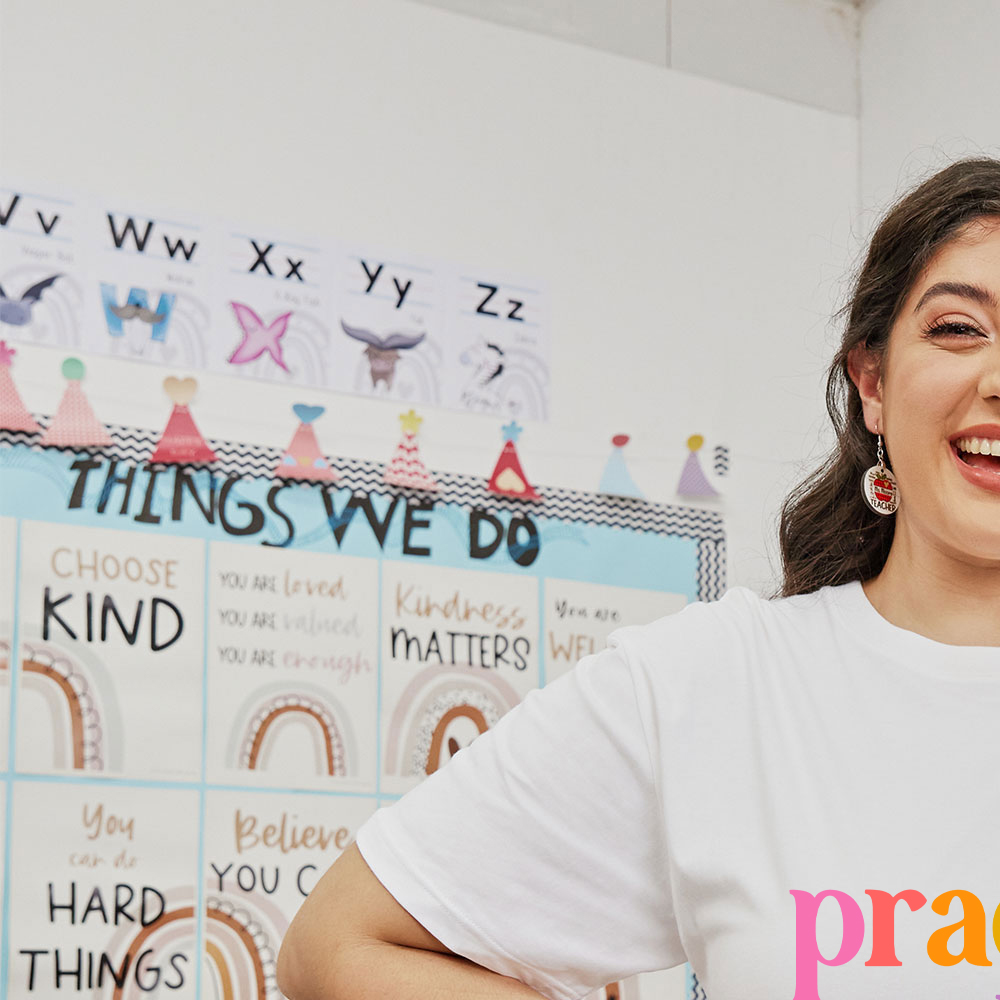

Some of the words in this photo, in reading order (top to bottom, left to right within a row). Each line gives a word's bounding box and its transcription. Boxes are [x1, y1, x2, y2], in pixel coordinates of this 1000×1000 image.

[67, 458, 295, 548] THINGS
[320, 485, 434, 557] WE
[469, 506, 541, 567] DO
[50, 547, 178, 589] CHOOSE
[218, 571, 248, 589] YOU
[252, 575, 277, 593] ARE
[283, 568, 349, 600] loved
[42, 586, 184, 652] KIND
[218, 609, 248, 627] YOU
[252, 611, 277, 630] ARE
[283, 608, 363, 639] valued
[395, 583, 526, 630] Kindness
[217, 646, 248, 664] YOU
[251, 648, 276, 667] ARE
[283, 650, 373, 685] enough
[83, 804, 135, 840] You
[235, 809, 349, 854] Believe
[211, 863, 279, 894] YOU
[48, 882, 165, 927] HARD
[20, 948, 189, 992] THINGS
